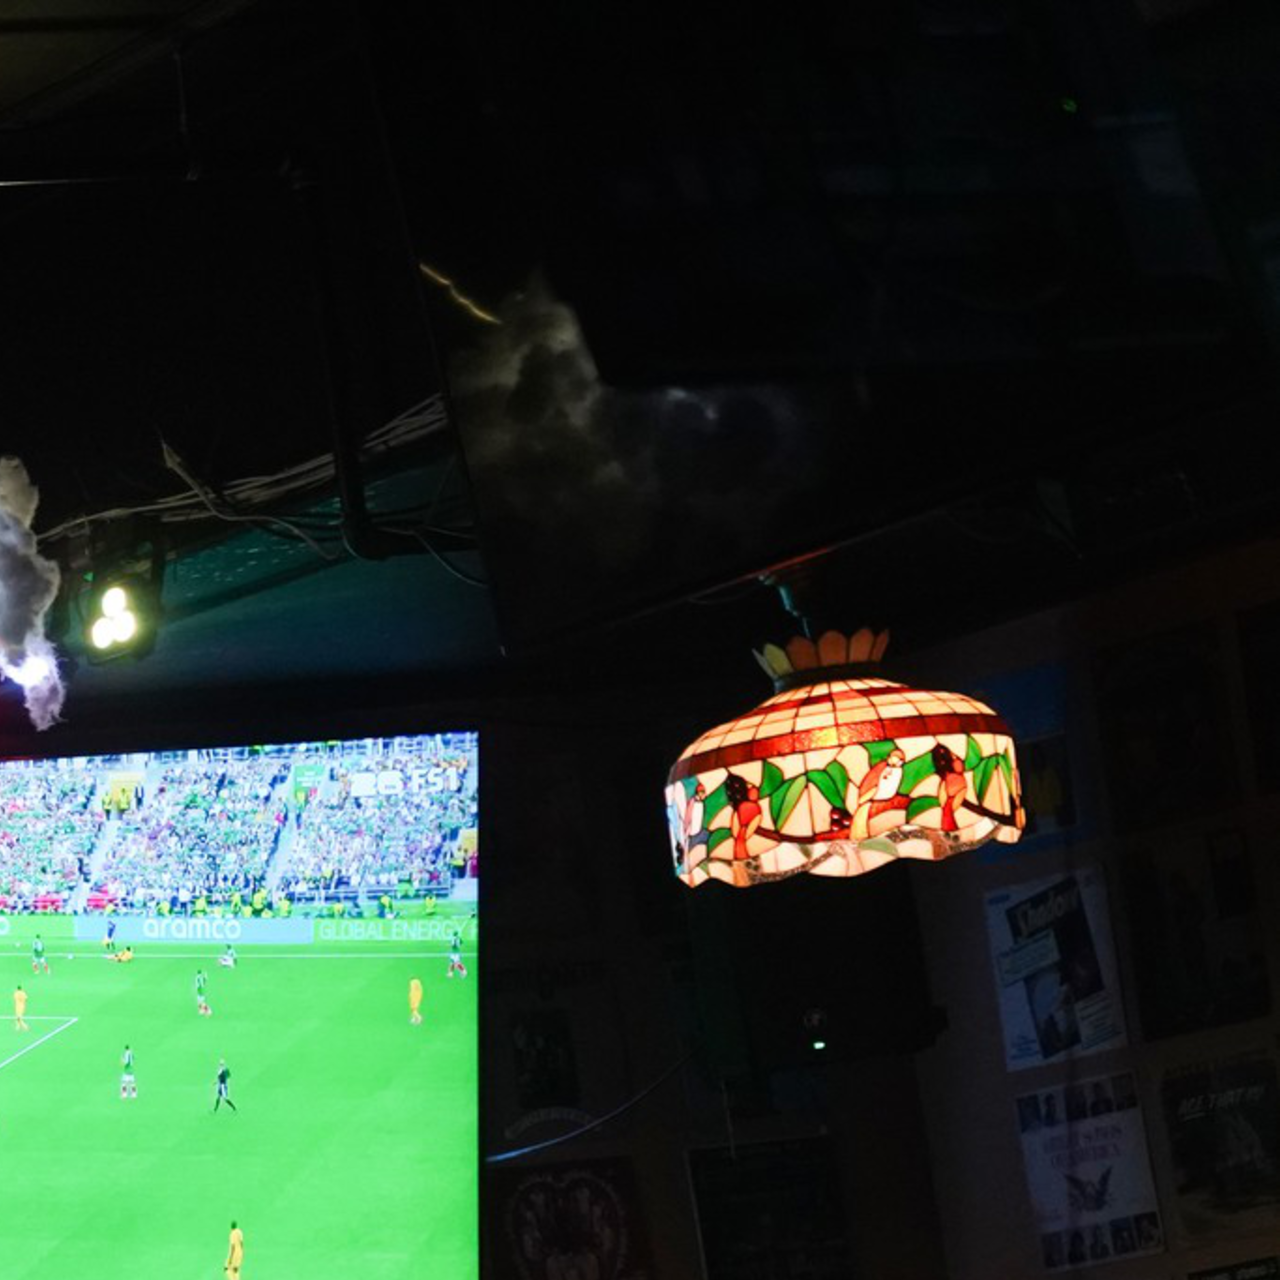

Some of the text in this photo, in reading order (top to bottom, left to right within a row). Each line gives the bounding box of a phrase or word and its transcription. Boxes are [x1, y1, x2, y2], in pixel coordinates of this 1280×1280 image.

[411, 766, 461, 793] FS1
[143, 917, 242, 940] aramco
[318, 919, 376, 941] GLOBAL
[377, 917, 467, 940] ENERGY
